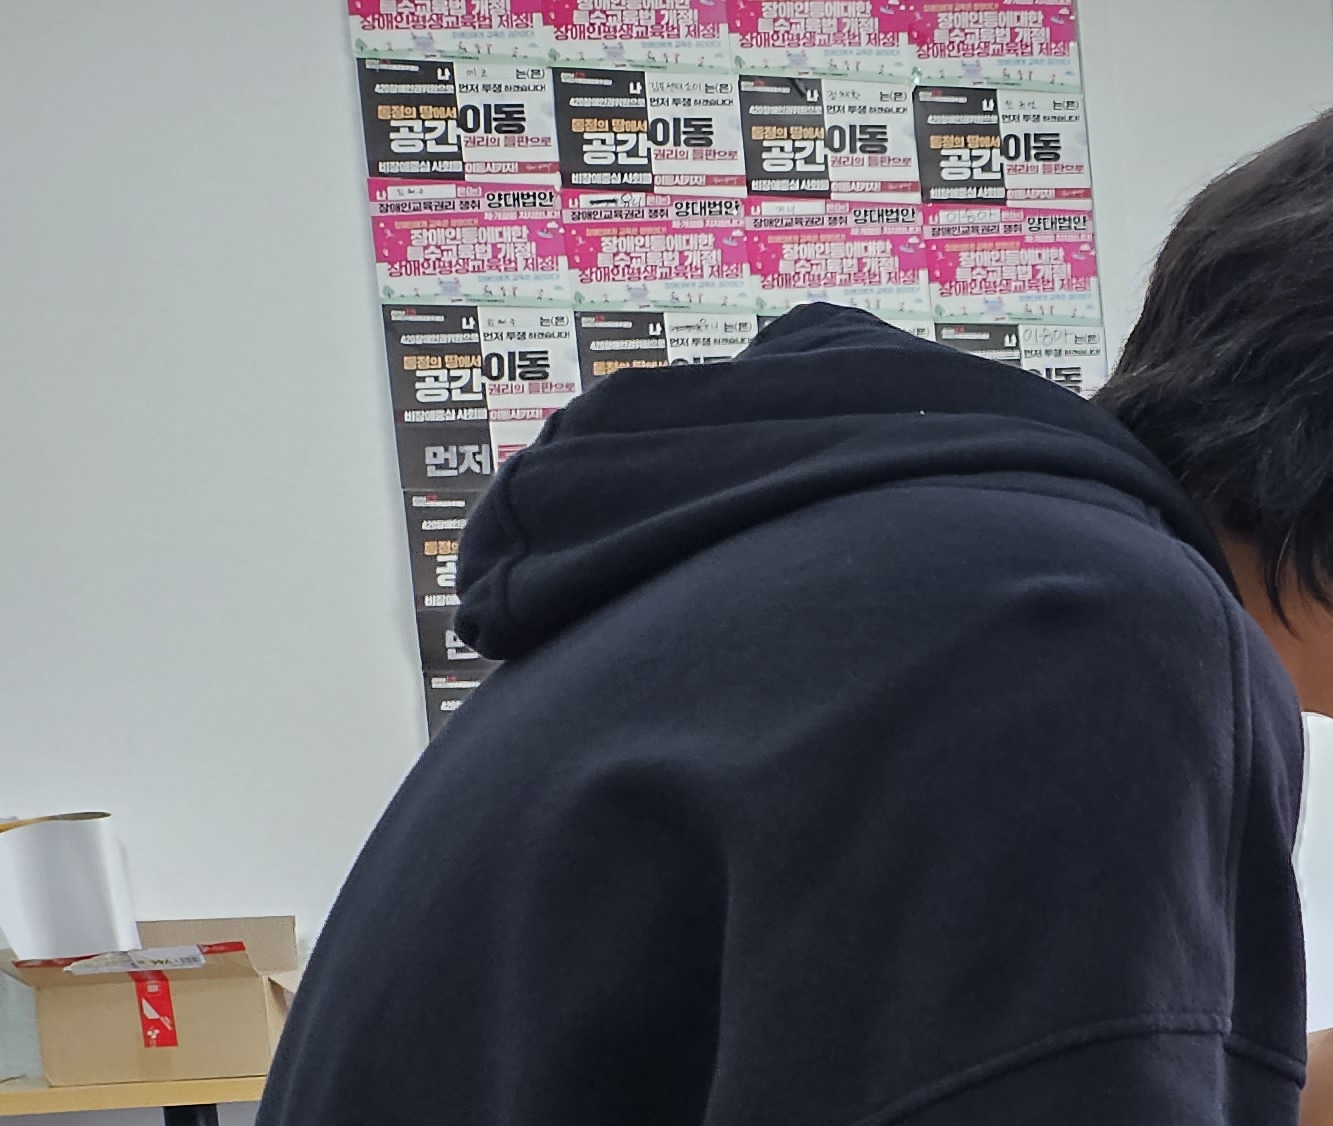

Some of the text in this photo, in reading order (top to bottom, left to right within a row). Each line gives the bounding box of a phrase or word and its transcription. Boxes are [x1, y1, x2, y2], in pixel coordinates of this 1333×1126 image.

[459, 83, 479, 93] 먼저
[389, 103, 526, 153] 공간 이동
[582, 117, 713, 165] 공간 이동
[762, 124, 888, 172] 공간 이동
[939, 132, 1062, 181] 공간 이동
[486, 191, 555, 208] 양대법안
[675, 200, 741, 218] 양대법안
[853, 207, 916, 225] 양대법안
[1027, 215, 1088, 232] 양대법안
[483, 331, 504, 342] 먼저
[415, 350, 550, 403] 공간 이동
[425, 443, 491, 477] 먼저
